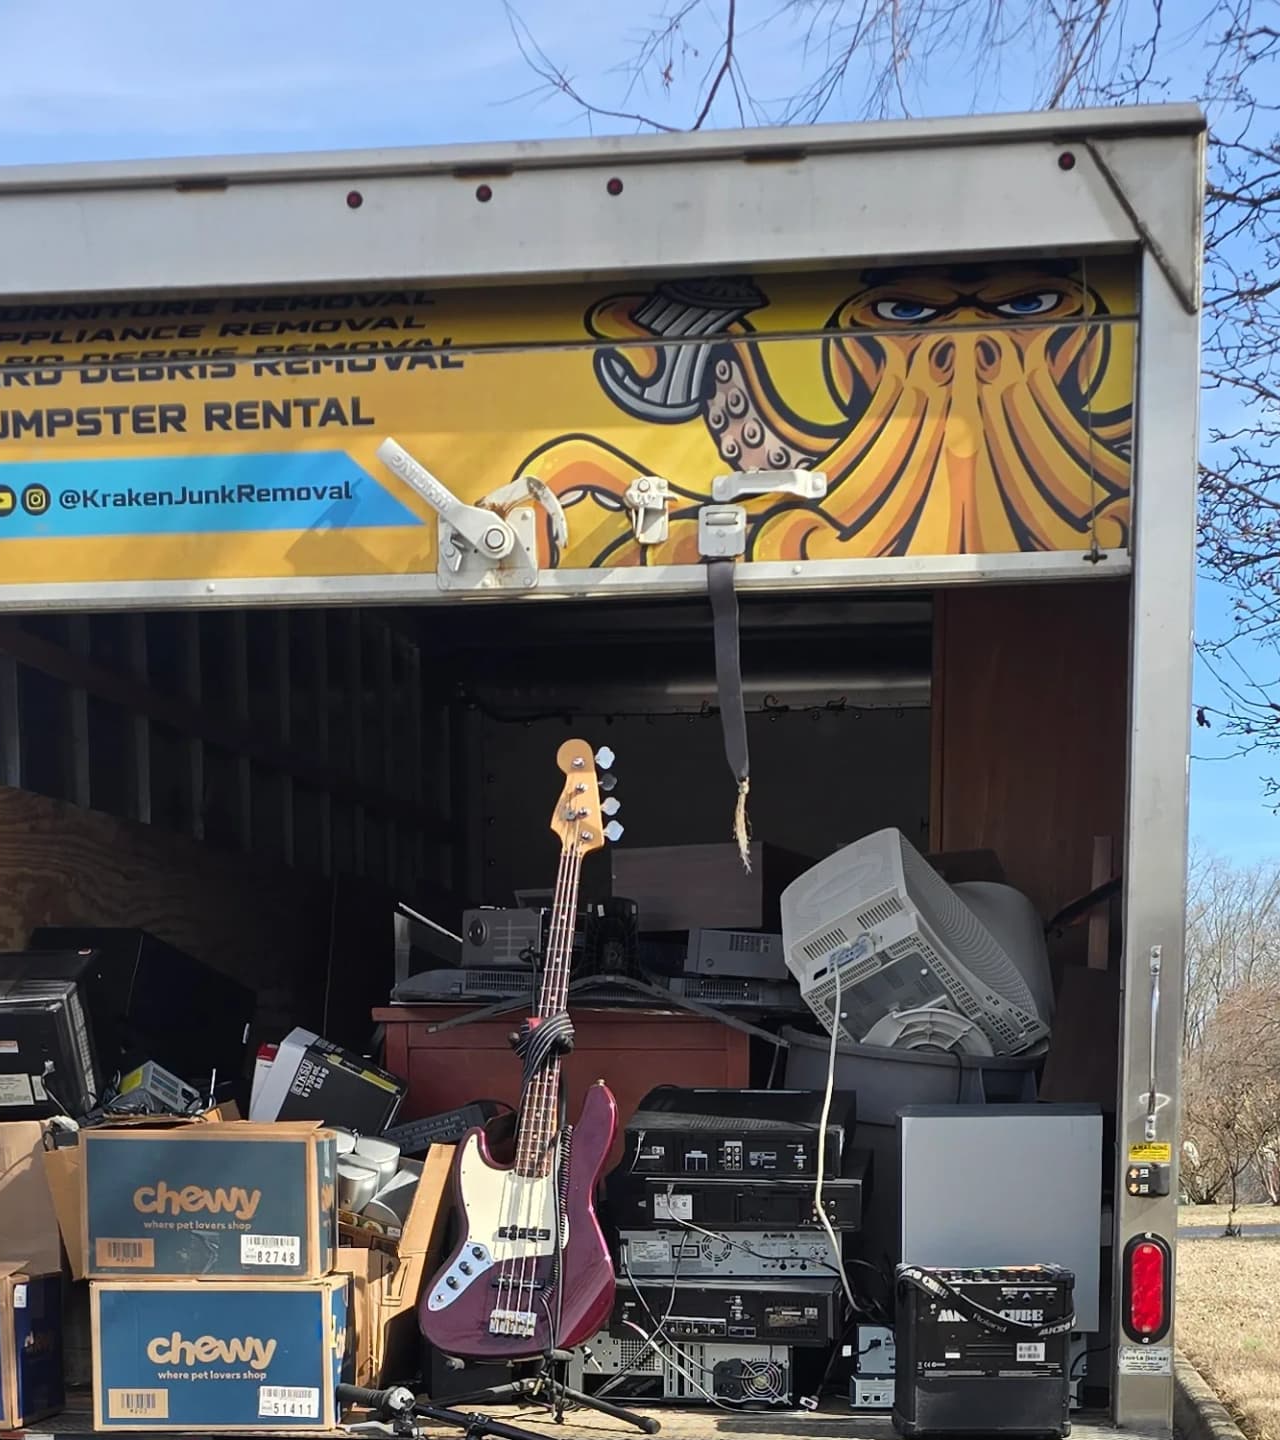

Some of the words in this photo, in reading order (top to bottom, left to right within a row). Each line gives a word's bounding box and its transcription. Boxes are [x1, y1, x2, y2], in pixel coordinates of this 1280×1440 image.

[218, 315, 426, 338] REMOVAL
[78, 346, 237, 384] DEBRIS
[251, 337, 464, 377] REMOVAL
[204, 396, 375, 430] RENTAL
[58, 480, 353, 510] @KrakenJunkRemoval
[133, 1180, 262, 1220] chewy
[144, 1220, 174, 1229] where
[176, 1221, 194, 1232] pet
[195, 1221, 226, 1230] lovers
[227, 1220, 252, 1231] shop
[257, 1250, 296, 1264] 82748
[972, 1312, 1008, 1333] Roland
[147, 1331, 277, 1370] chewy
[158, 1370, 189, 1379] where
[191, 1371, 209, 1381] pet
[210, 1370, 241, 1380] lovers
[243, 1370, 267, 1381] shop
[273, 1402, 313, 1415] 51411
